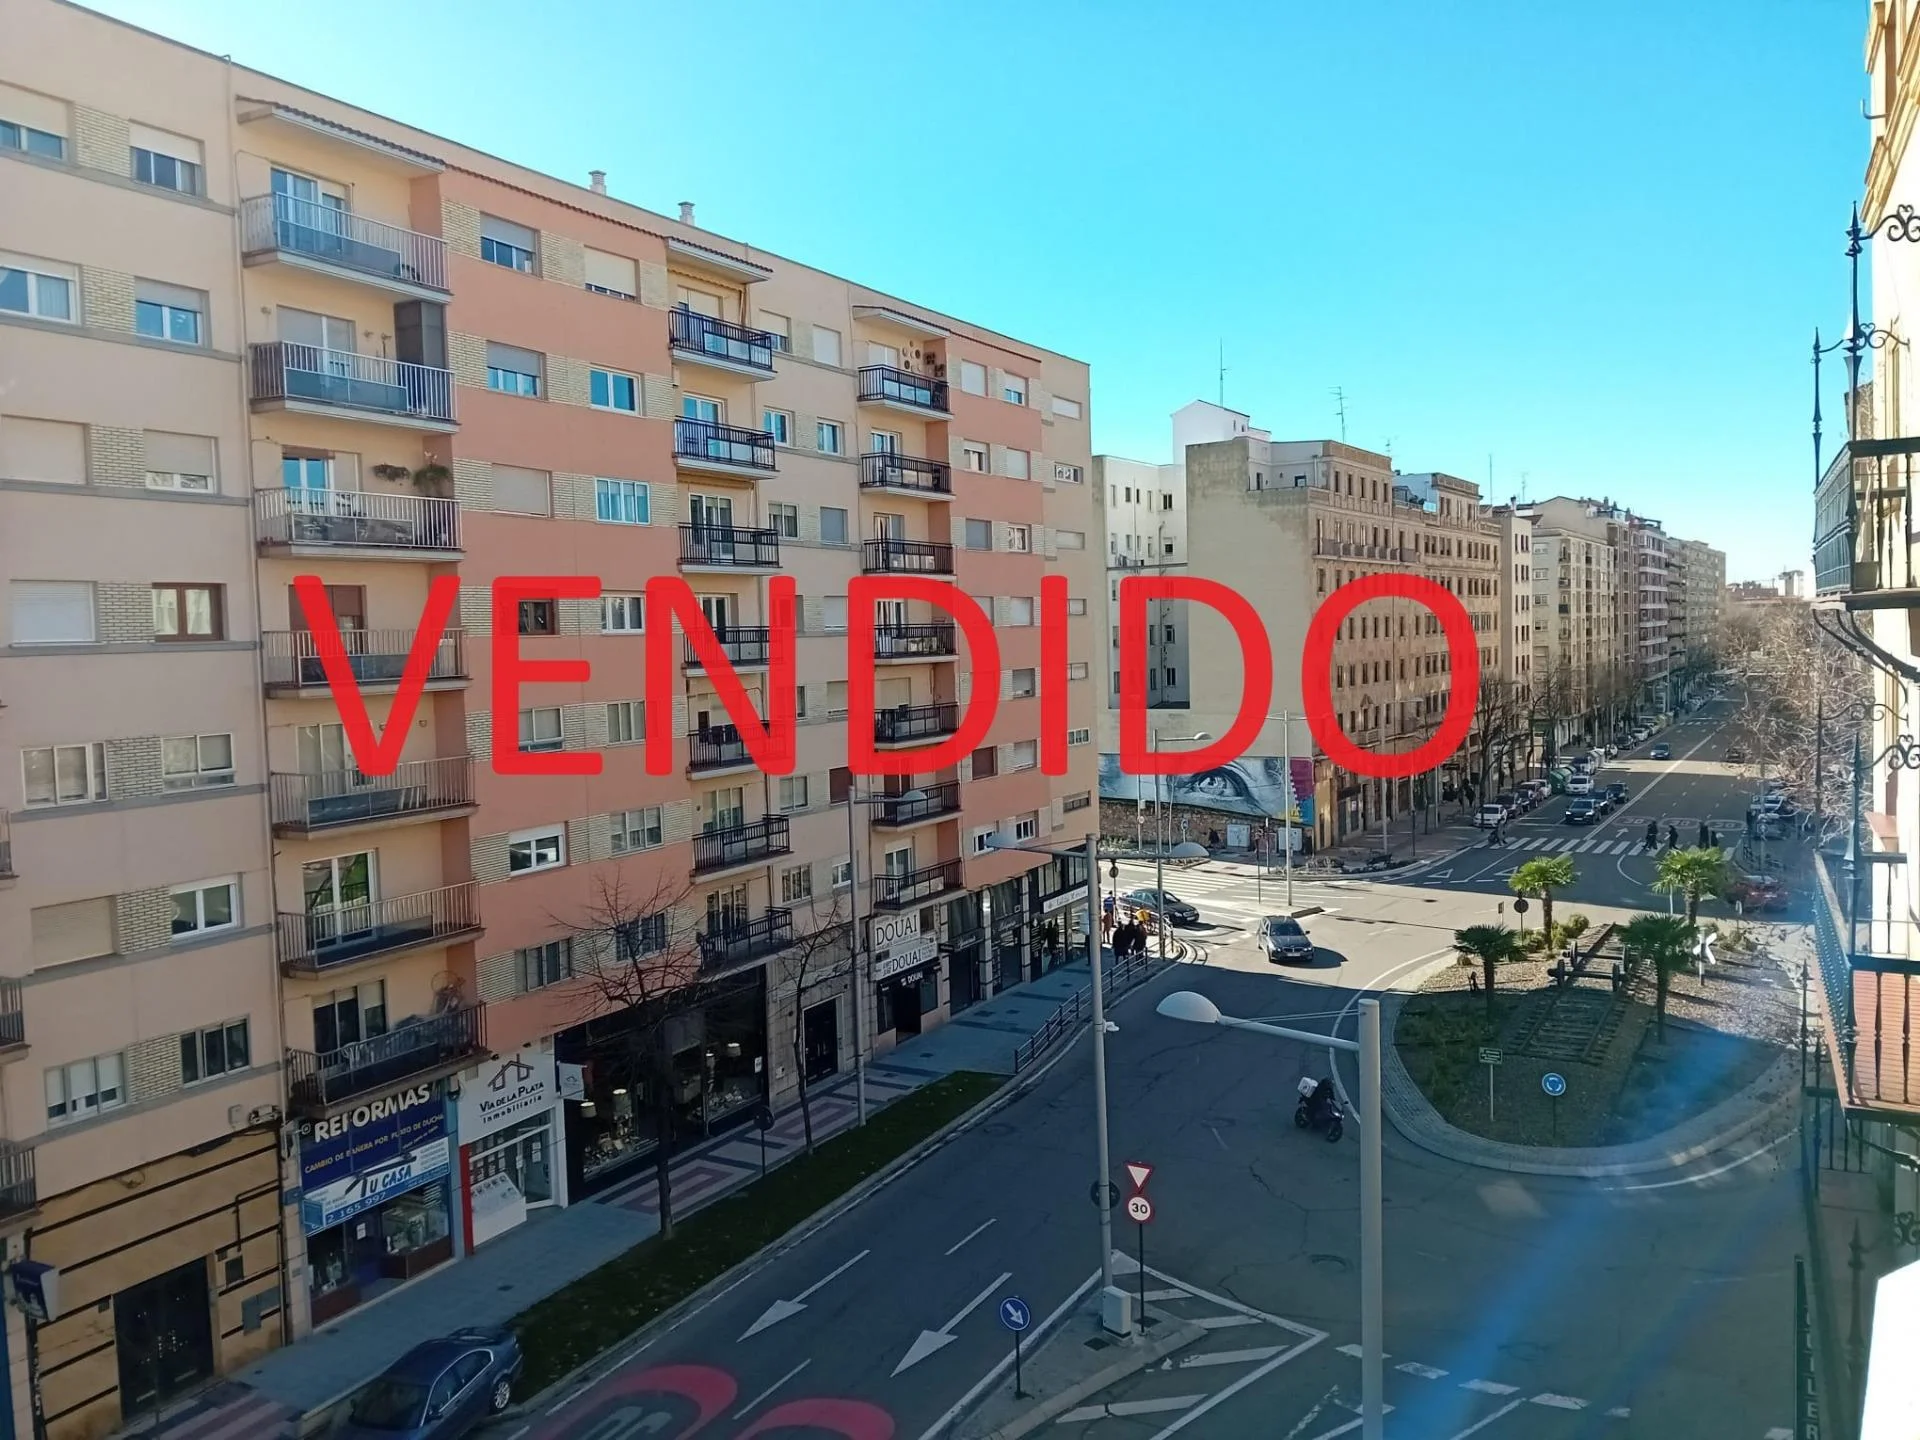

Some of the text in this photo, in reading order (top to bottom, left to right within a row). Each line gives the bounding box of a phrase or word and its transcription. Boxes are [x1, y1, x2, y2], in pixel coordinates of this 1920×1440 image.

[876, 914, 917, 946] DOUAI
[892, 948, 922, 972] DOUAI
[304, 1156, 333, 1174] CAMBIO
[335, 1152, 345, 1161] DE
[374, 1135, 388, 1146] POR
[413, 1122, 421, 1131] DE
[382, 1164, 412, 1188] CASA
[1131, 1202, 1148, 1214] 30
